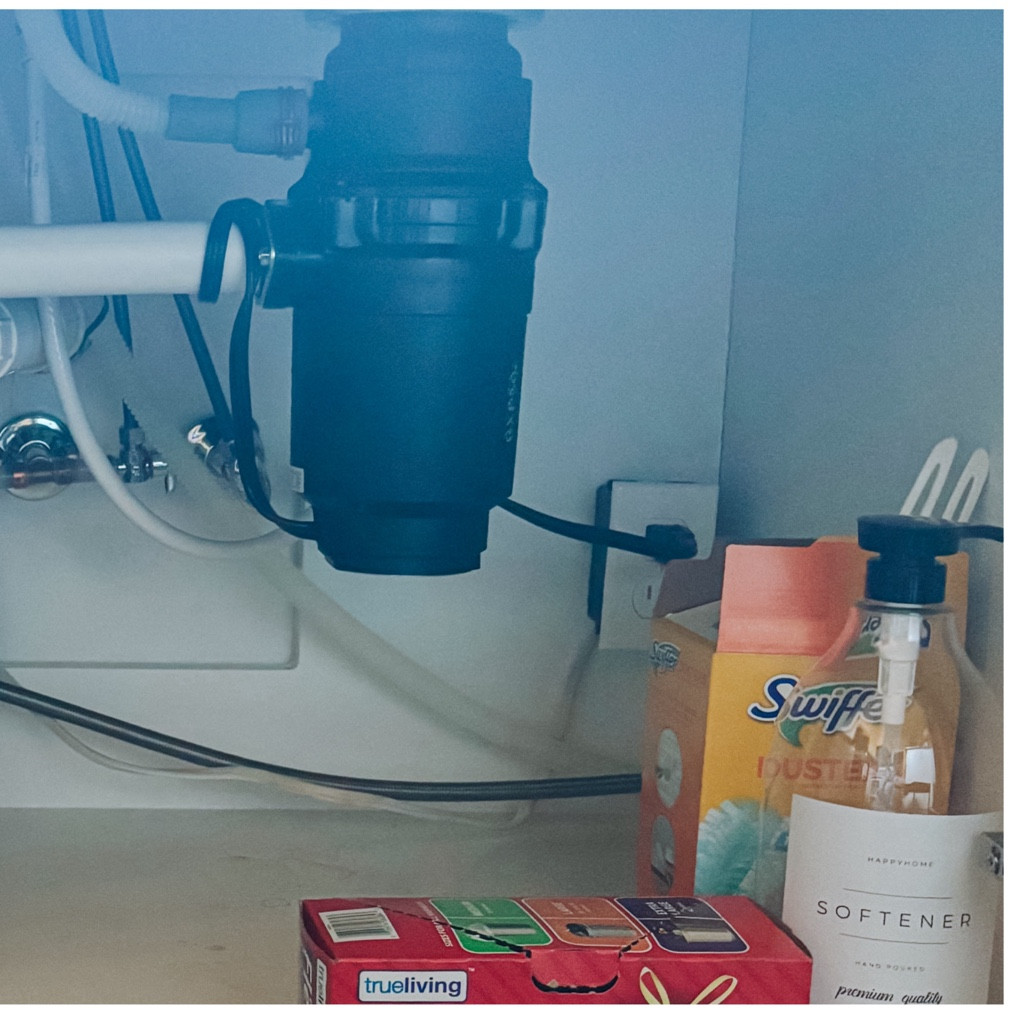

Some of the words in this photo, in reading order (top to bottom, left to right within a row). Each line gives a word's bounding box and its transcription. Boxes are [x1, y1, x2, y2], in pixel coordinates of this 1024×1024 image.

[747, 675, 904, 733] Swiffe
[757, 756, 867, 781] DUSTE
[867, 857, 934, 868] HAPPYHOME
[817, 900, 971, 929] SOFTENER
[855, 960, 881, 969] HAND
[886, 963, 926, 972] POURED
[364, 977, 462, 997] trueliving
[834, 985, 894, 1002] premium
[901, 991, 943, 1005] quality
